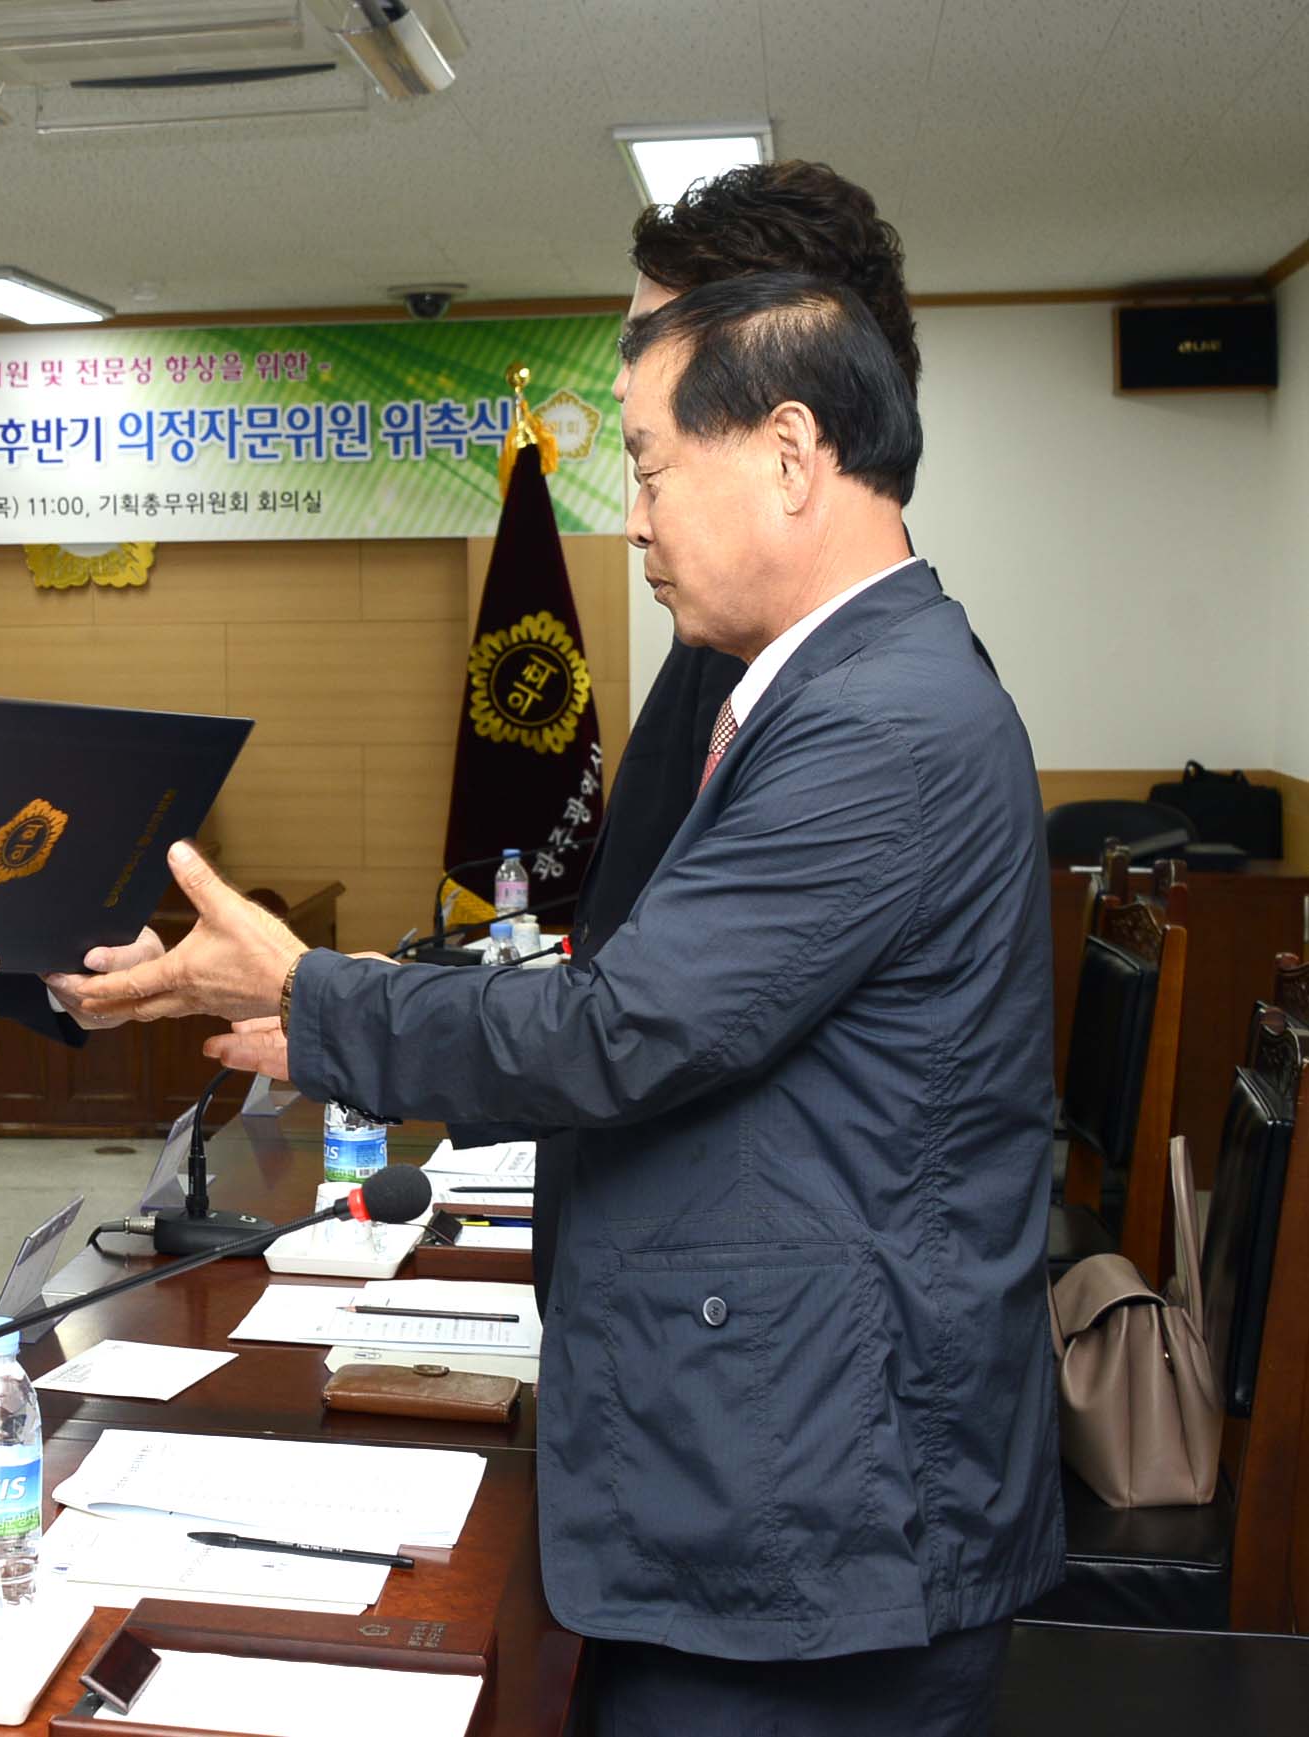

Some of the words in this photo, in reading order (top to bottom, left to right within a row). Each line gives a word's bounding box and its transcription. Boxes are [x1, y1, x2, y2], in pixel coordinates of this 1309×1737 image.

[40, 359, 64, 388] 및
[75, 356, 153, 386] 전문성
[164, 352, 243, 384] 향상을
[255, 350, 309, 382] 위한
[118, 404, 368, 463] 의정자문위원
[382, 400, 511, 458] 위촉식
[29, 498, 90, 518] 11:00,
[98, 492, 249, 517] 기획총무위원회
[257, 489, 323, 515] 회의실
[507, 653, 559, 716] 의회
